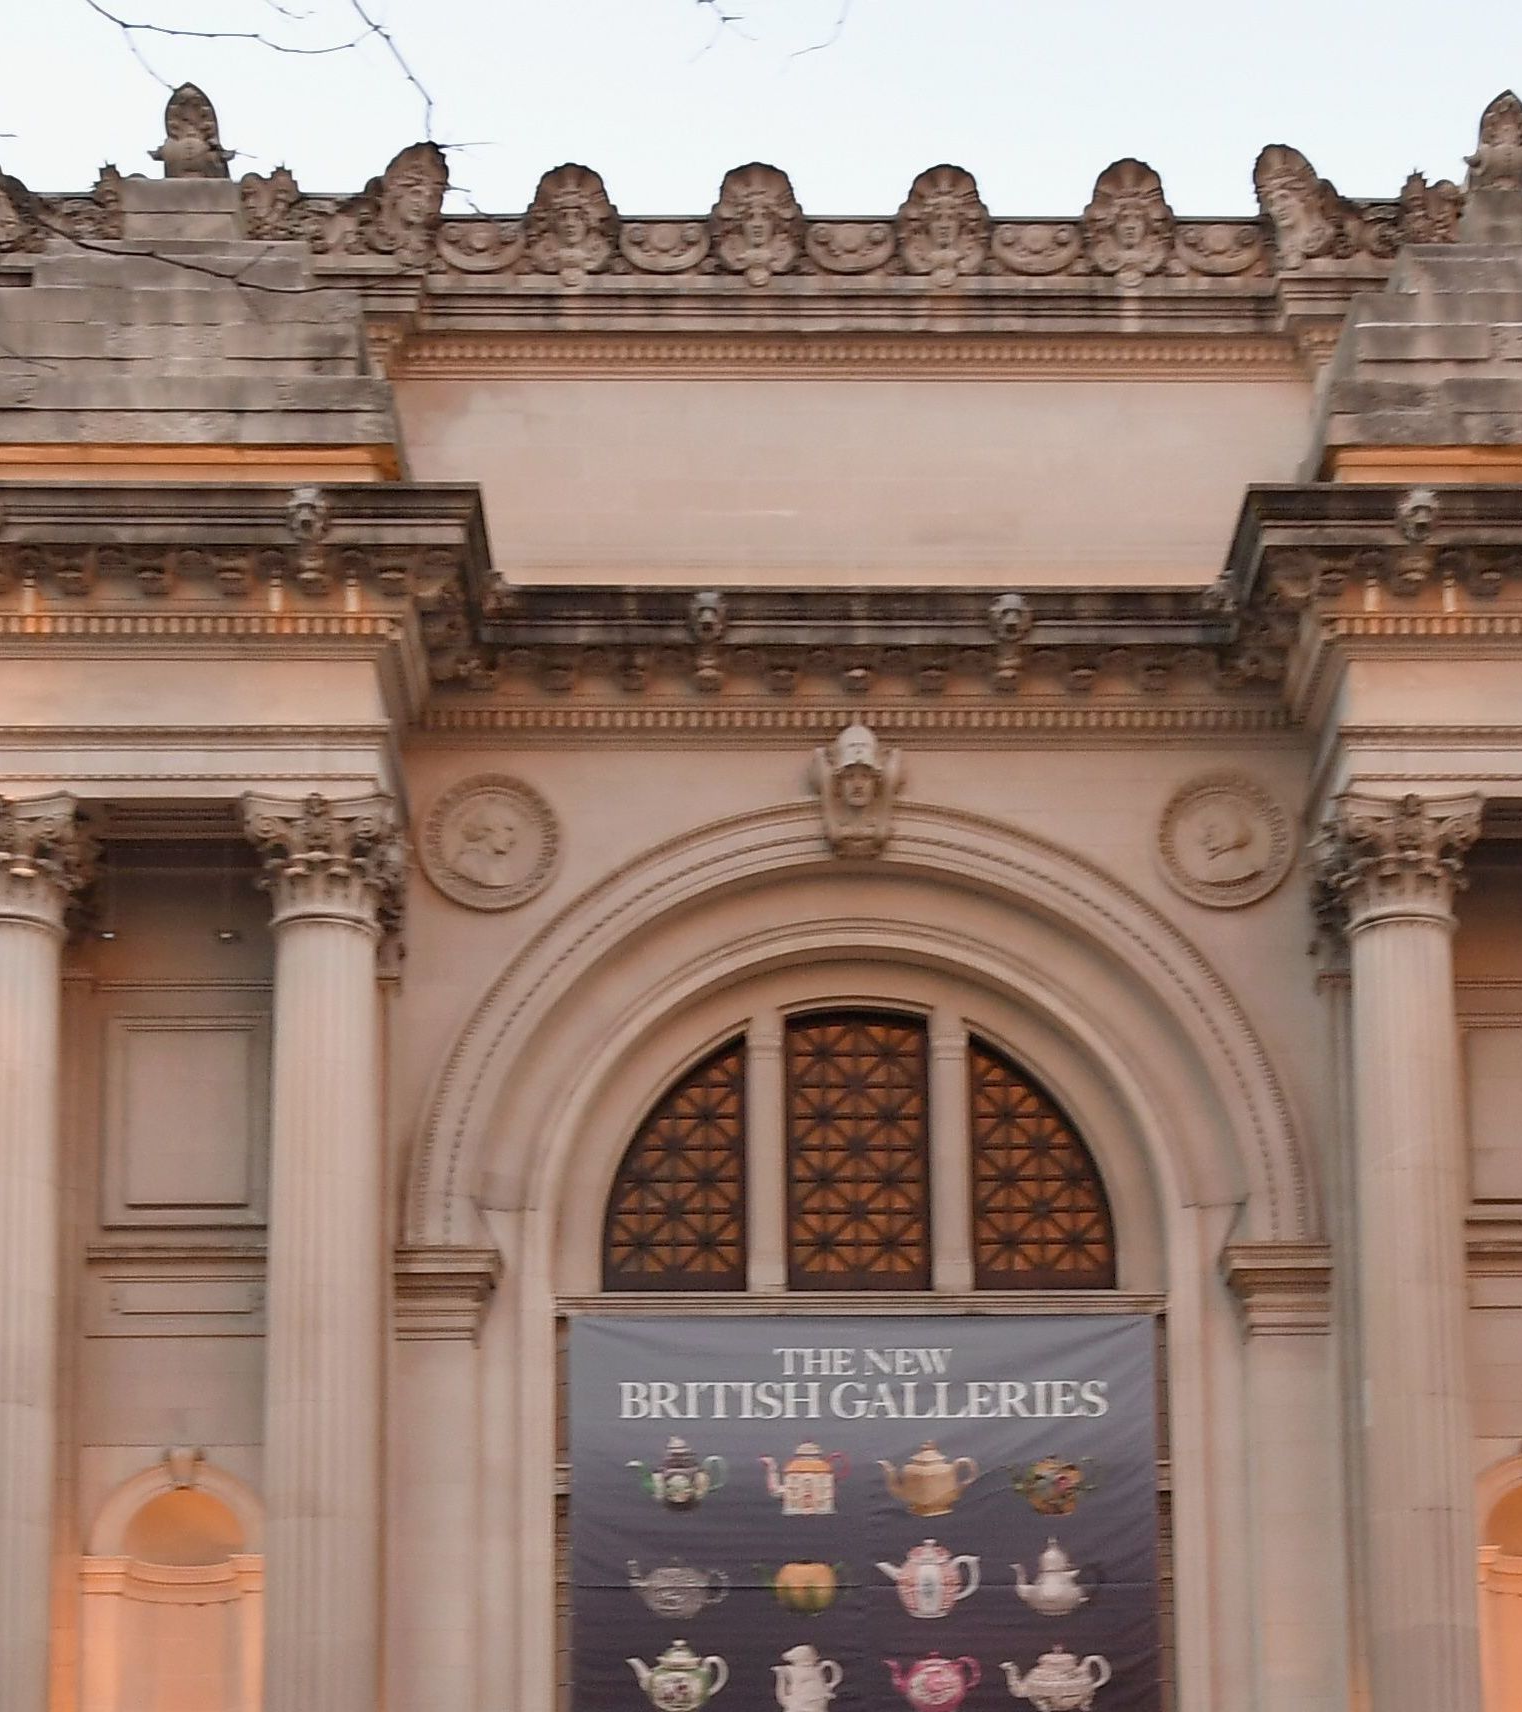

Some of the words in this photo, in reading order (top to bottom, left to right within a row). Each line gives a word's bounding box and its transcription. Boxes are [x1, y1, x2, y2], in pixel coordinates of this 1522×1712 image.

[773, 1347, 856, 1376] THE
[864, 1347, 953, 1376] NEW
[617, 1381, 823, 1420] BRITISH
[829, 1379, 1110, 1419] GALLERIES
